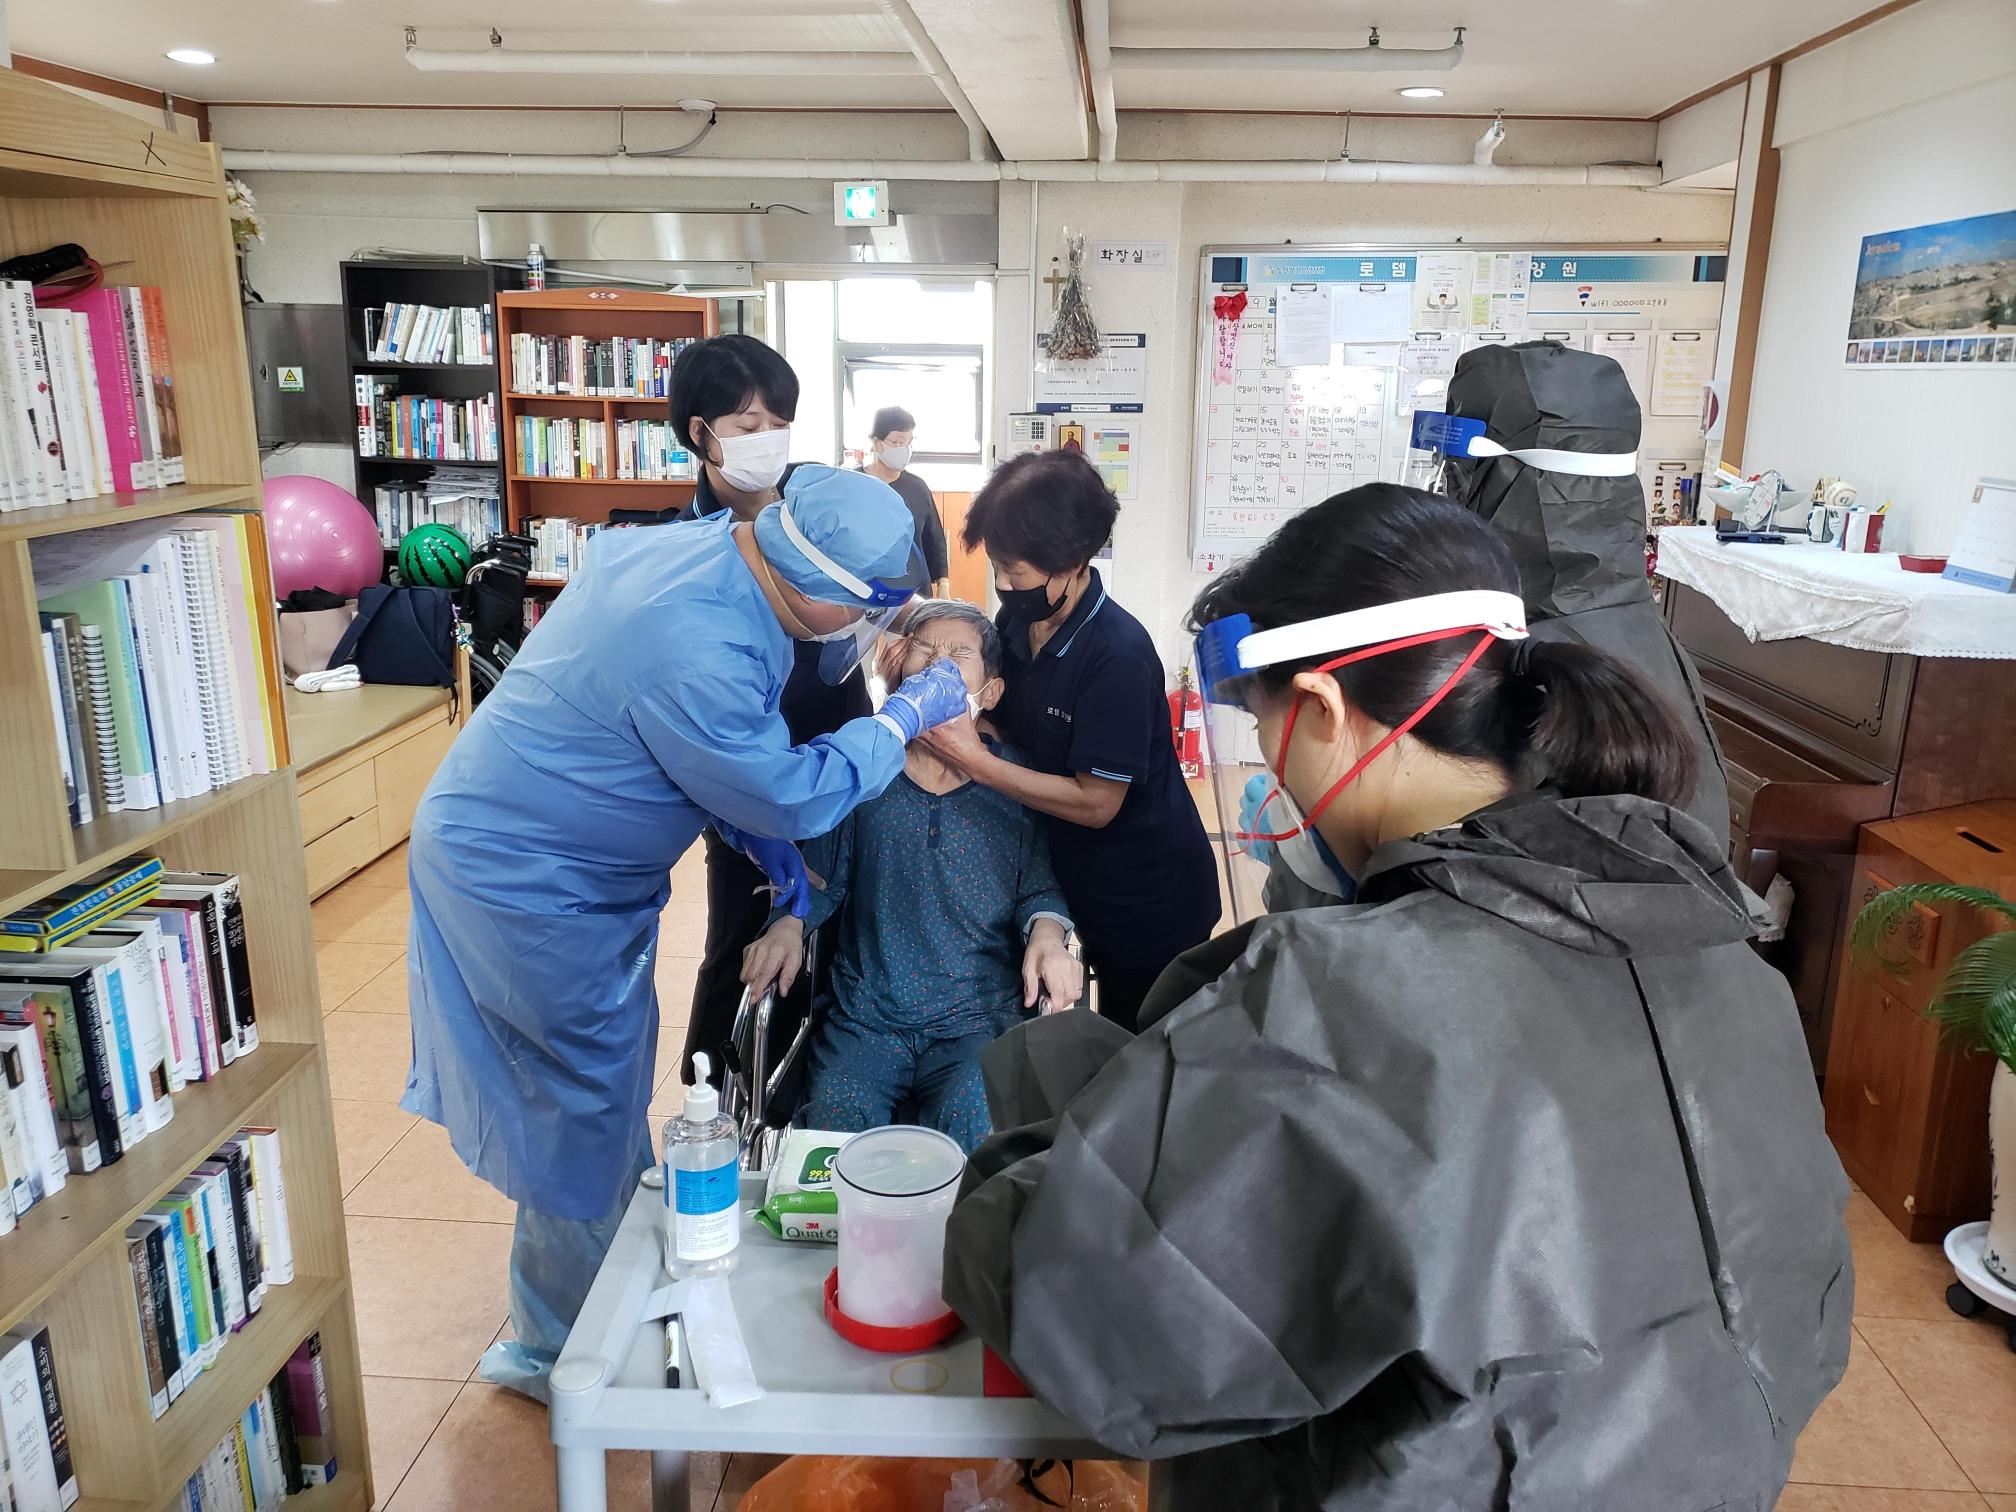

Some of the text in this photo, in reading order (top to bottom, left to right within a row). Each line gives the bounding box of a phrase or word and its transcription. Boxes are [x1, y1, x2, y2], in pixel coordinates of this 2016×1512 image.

[1100, 249, 1143, 263] 화장실
[1253, 297, 1260, 308] 9
[1261, 371, 1268, 379] 8
[1284, 371, 1292, 379] 9
[1256, 440, 1268, 448] 22
[1280, 440, 1290, 449] 23
[1197, 553, 1224, 562] 소화기
[805, 1222, 820, 1230] 3M
